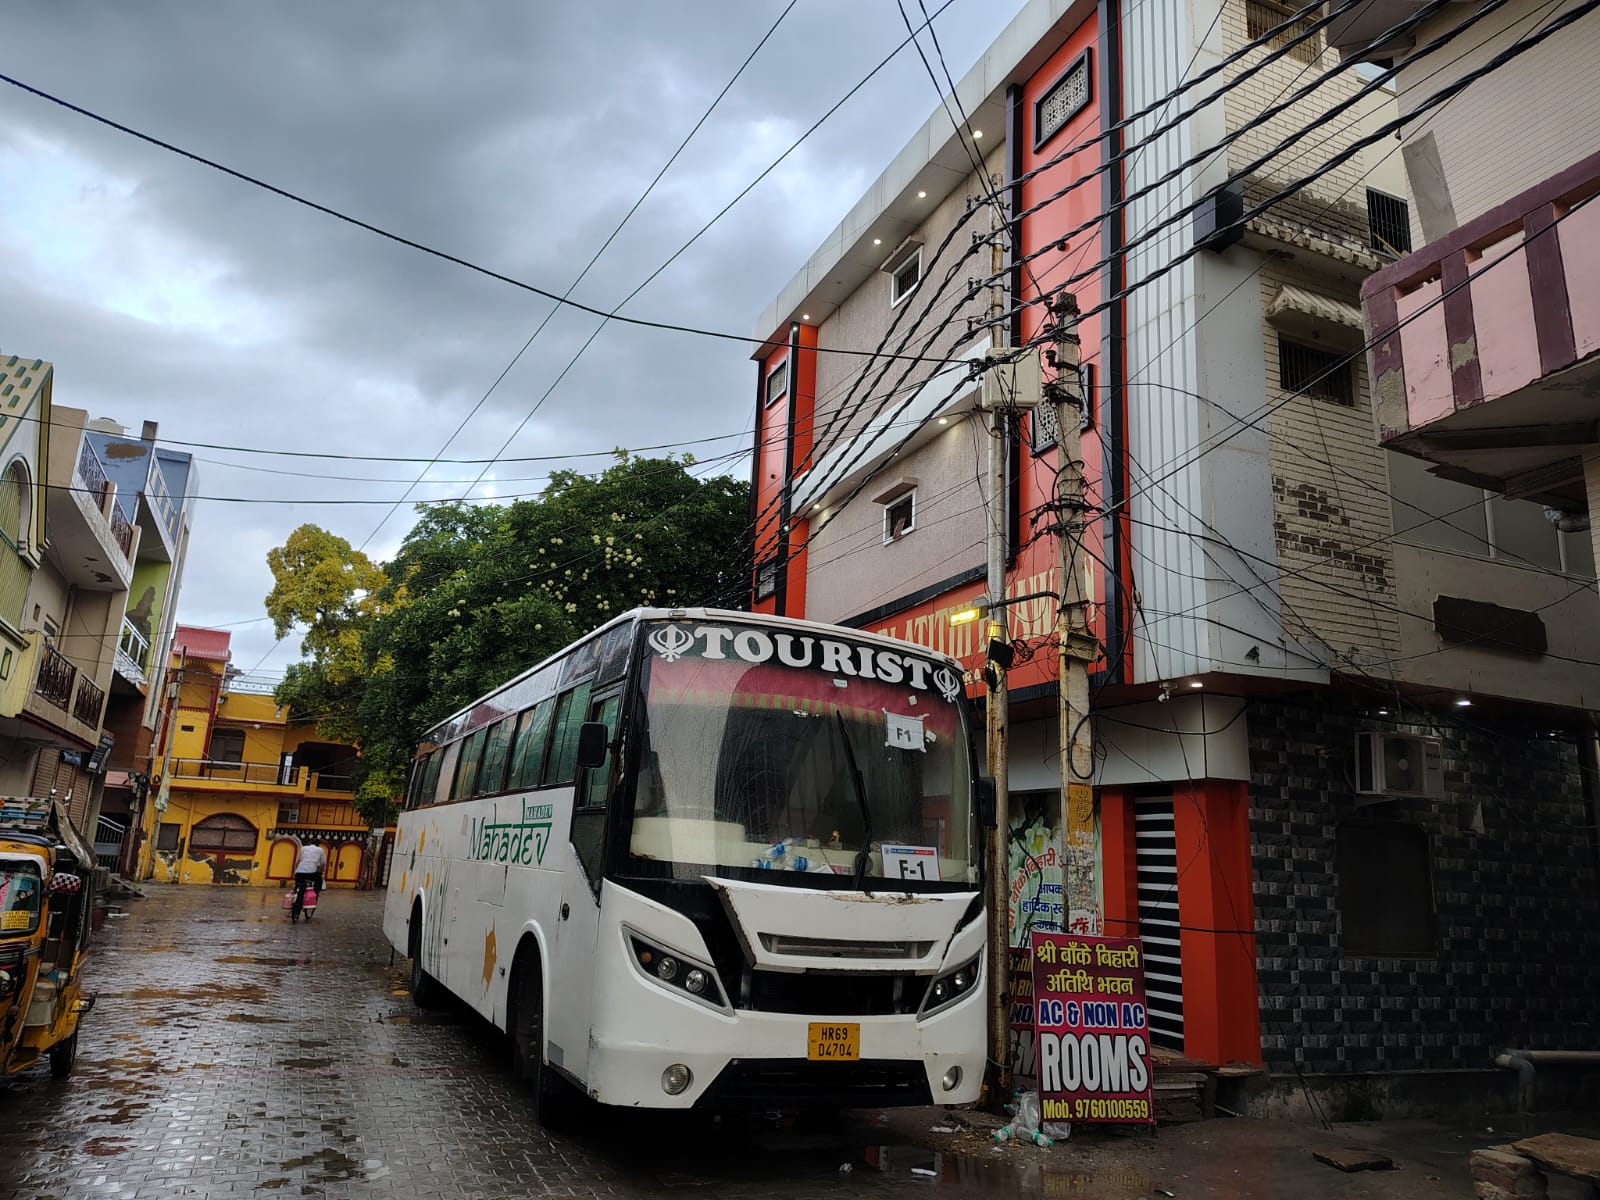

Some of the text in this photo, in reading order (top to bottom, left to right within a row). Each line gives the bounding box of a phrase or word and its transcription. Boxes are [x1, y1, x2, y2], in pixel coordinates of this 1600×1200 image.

[694, 627, 932, 690] TOURIST
[896, 727, 912, 743] F1
[899, 859, 926, 880] F-1
[1037, 939, 1139, 968] श्री बाँके बिहारी
[1046, 969, 1094, 993] अतिथि
[1097, 976, 1134, 995] भवन
[1039, 1000, 1144, 1028] AC & NON AC
[821, 1027, 848, 1041] HR69
[1040, 1031, 1148, 1093] ROOMS
[1042, 1098, 1073, 1119] Mob.
[1075, 1099, 1149, 1119] 9760100559
